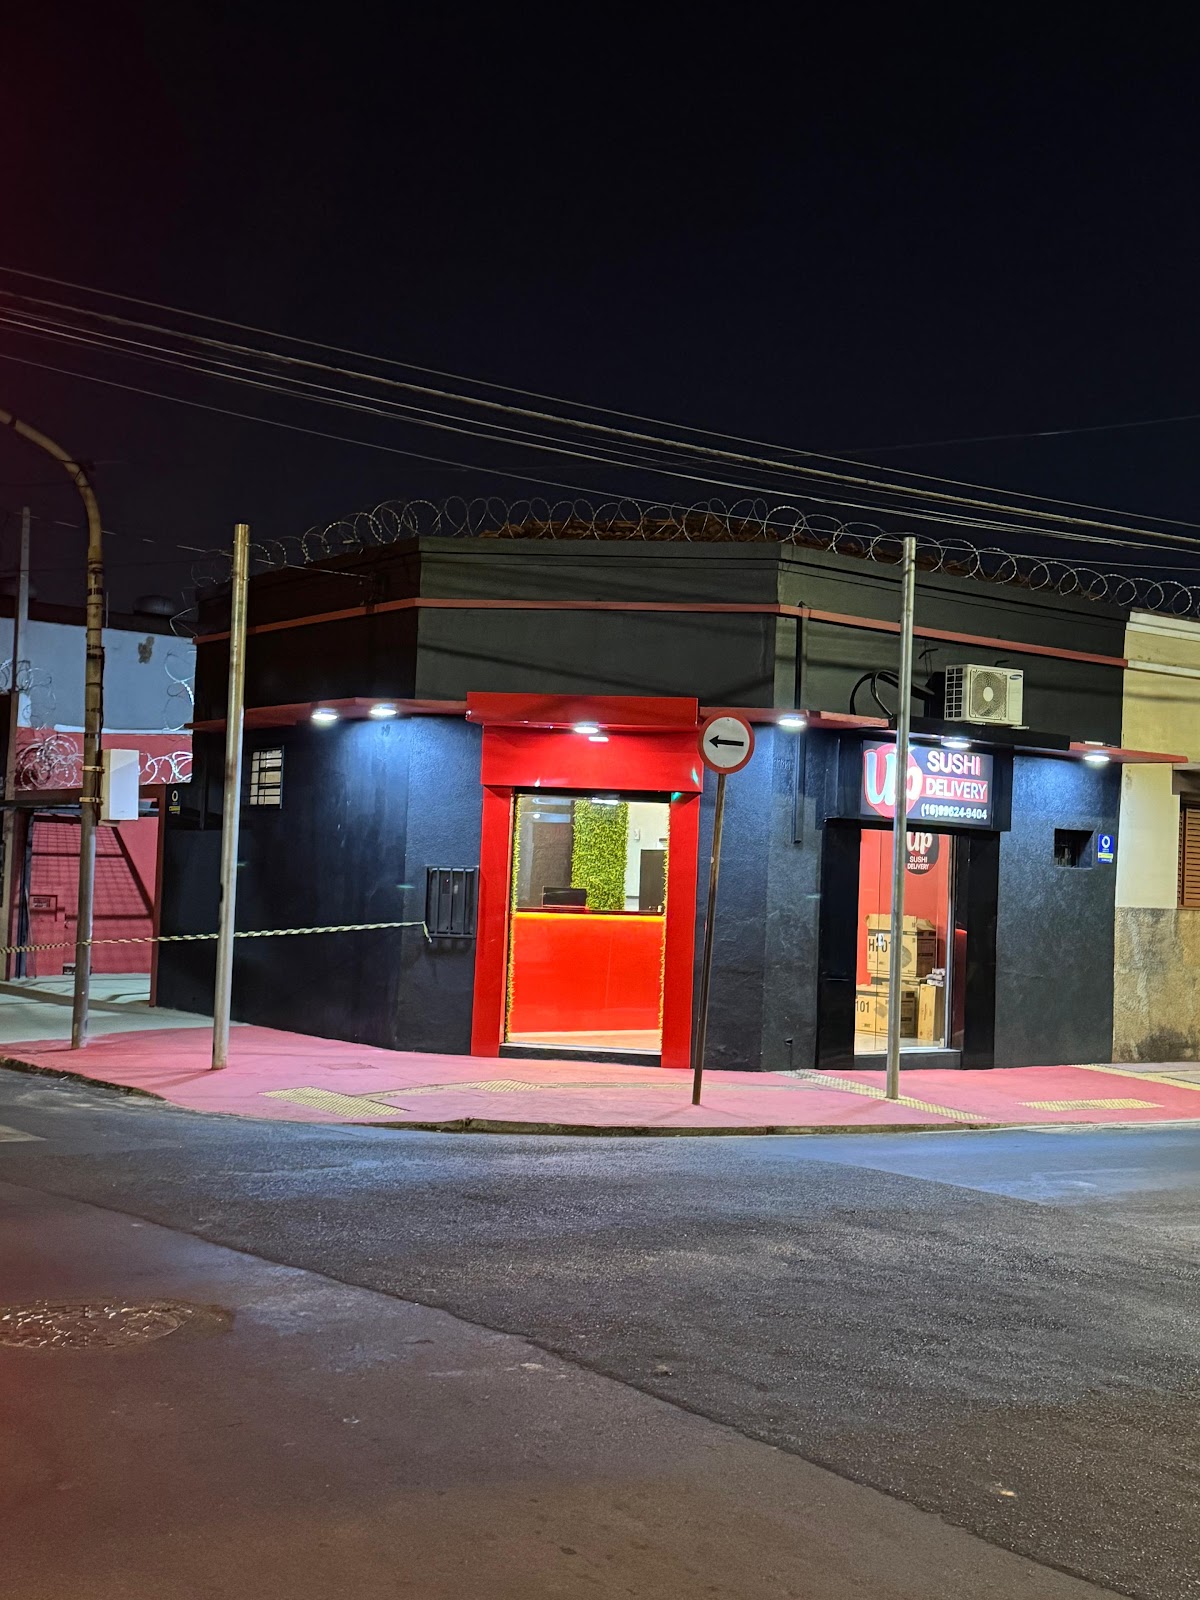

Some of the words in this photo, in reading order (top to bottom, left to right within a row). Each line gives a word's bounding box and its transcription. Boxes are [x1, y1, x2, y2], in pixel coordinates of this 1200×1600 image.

[927, 750, 981, 776] SUSHI
[926, 778, 988, 800] DELIVERY
[909, 855, 928, 863] SUSHI
